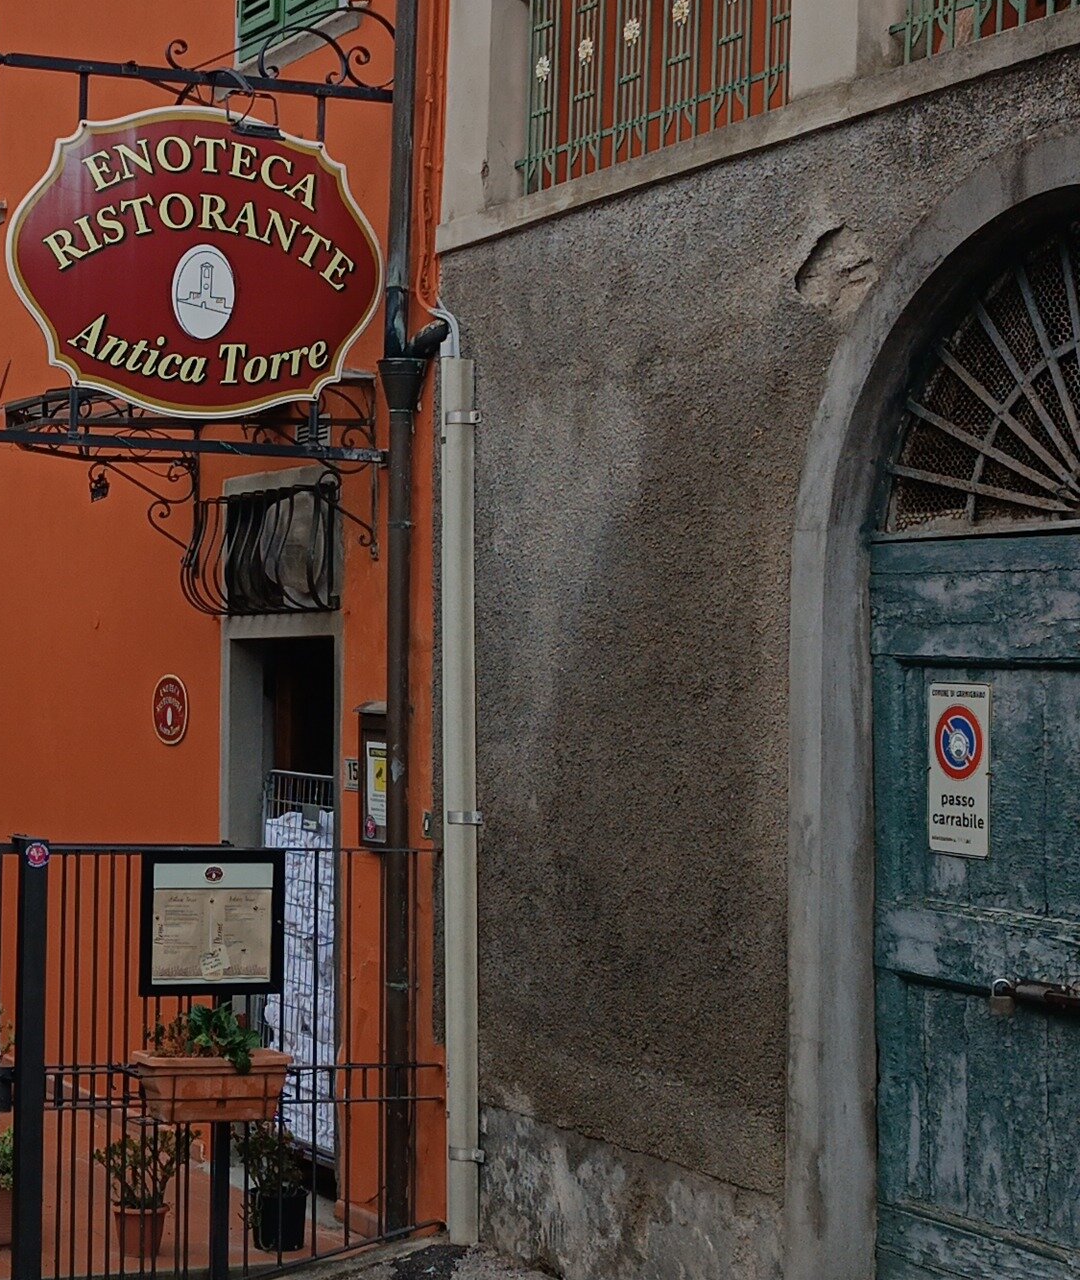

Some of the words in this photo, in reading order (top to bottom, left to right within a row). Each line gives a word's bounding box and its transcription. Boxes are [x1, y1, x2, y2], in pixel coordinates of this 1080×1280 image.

[81, 134, 318, 212] ENOTECA
[43, 193, 356, 292] RISTORANTE
[67, 313, 209, 386] Antica
[218, 338, 329, 385] Torre
[348, 761, 358, 781] 15
[932, 812, 985, 830] carrabile
[941, 792, 976, 808] passo
